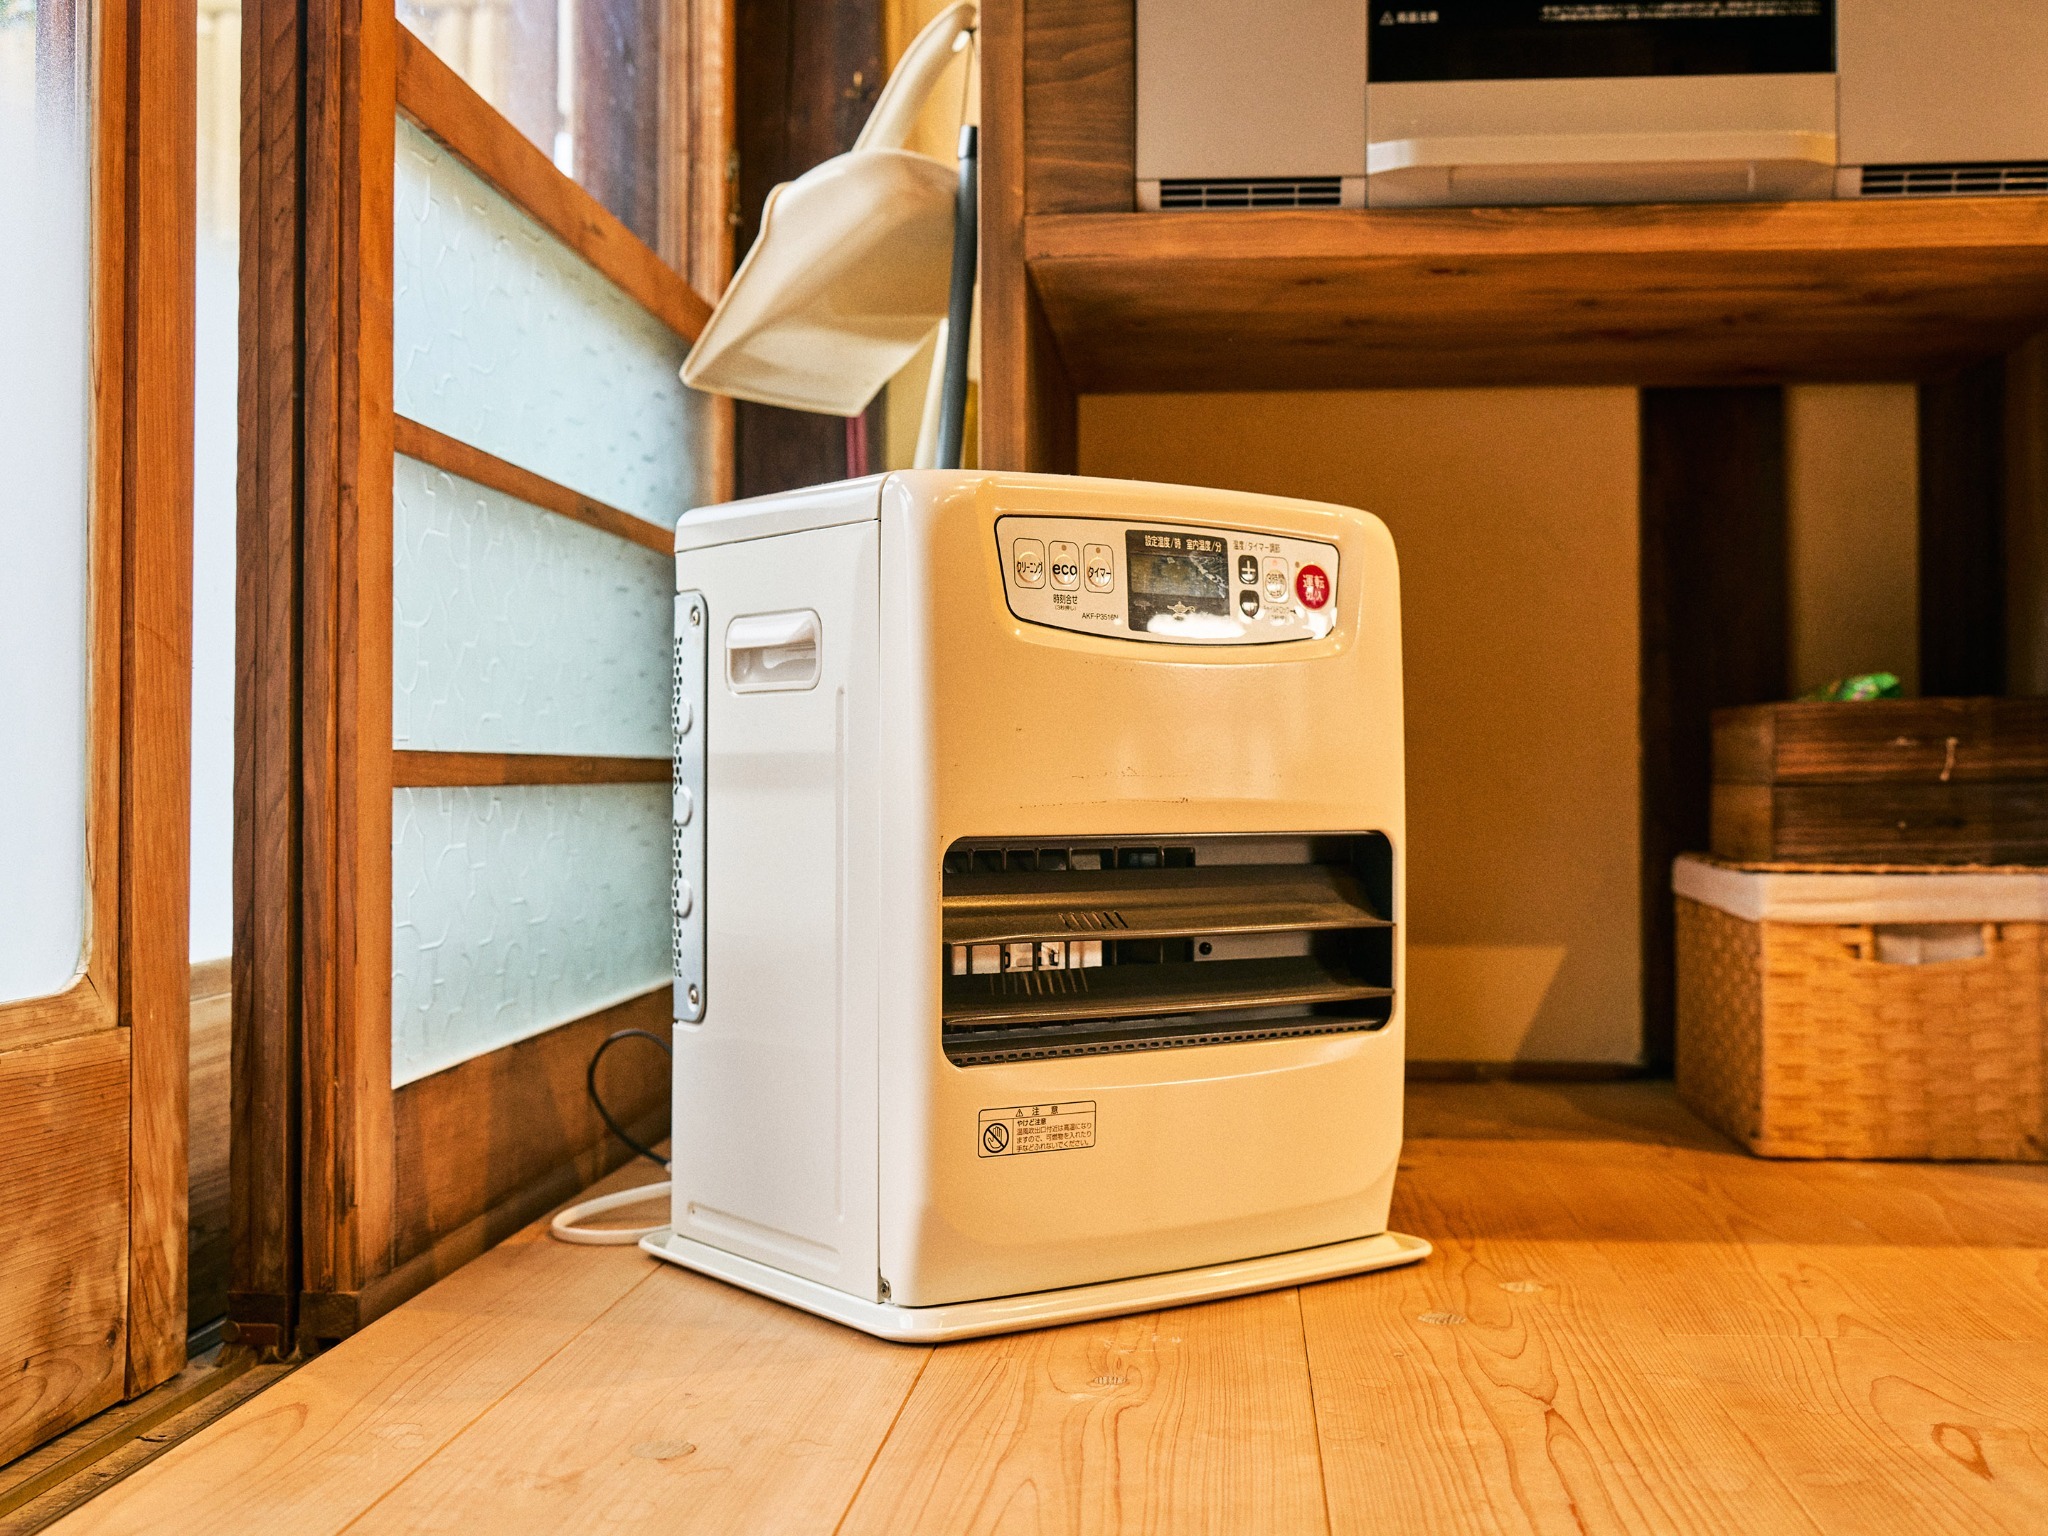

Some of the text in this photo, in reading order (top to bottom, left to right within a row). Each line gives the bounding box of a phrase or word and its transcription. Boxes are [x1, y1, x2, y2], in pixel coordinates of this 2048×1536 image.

[1144, 535, 1181, 549] 設定温度/時
[1186, 539, 1222, 552] 室内温度/分
[1017, 561, 1043, 574] クリーニング
[1052, 563, 1078, 575] eco
[1089, 567, 1112, 578] タイマー
[1302, 574, 1325, 590] 運転
[1053, 594, 1078, 605] 時刻合せ
[1017, 1118, 1047, 1127] やけど注意
